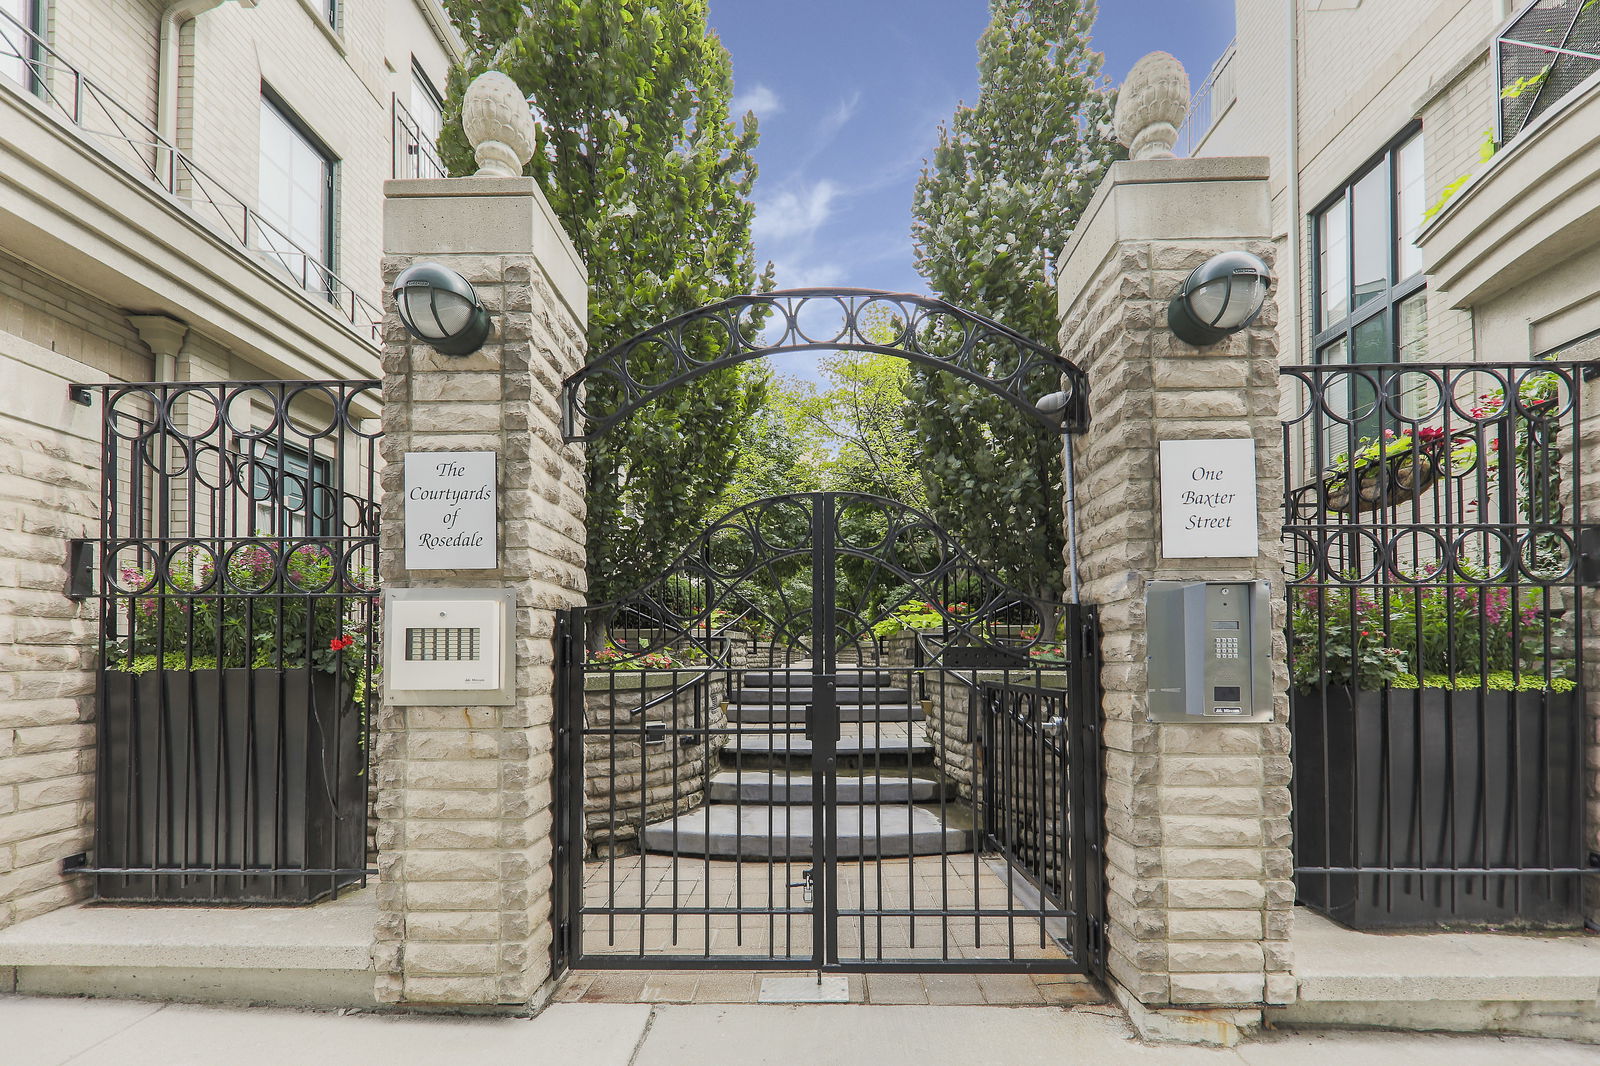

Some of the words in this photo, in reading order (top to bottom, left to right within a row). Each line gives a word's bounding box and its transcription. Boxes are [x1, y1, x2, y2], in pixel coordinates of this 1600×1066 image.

[436, 461, 465, 477] The
[1192, 466, 1224, 482] One
[410, 484, 492, 507] Courtyards
[1181, 490, 1236, 508] Baxter
[443, 508, 461, 530] of
[1185, 514, 1232, 530] Street
[418, 531, 483, 550] Rosedale
